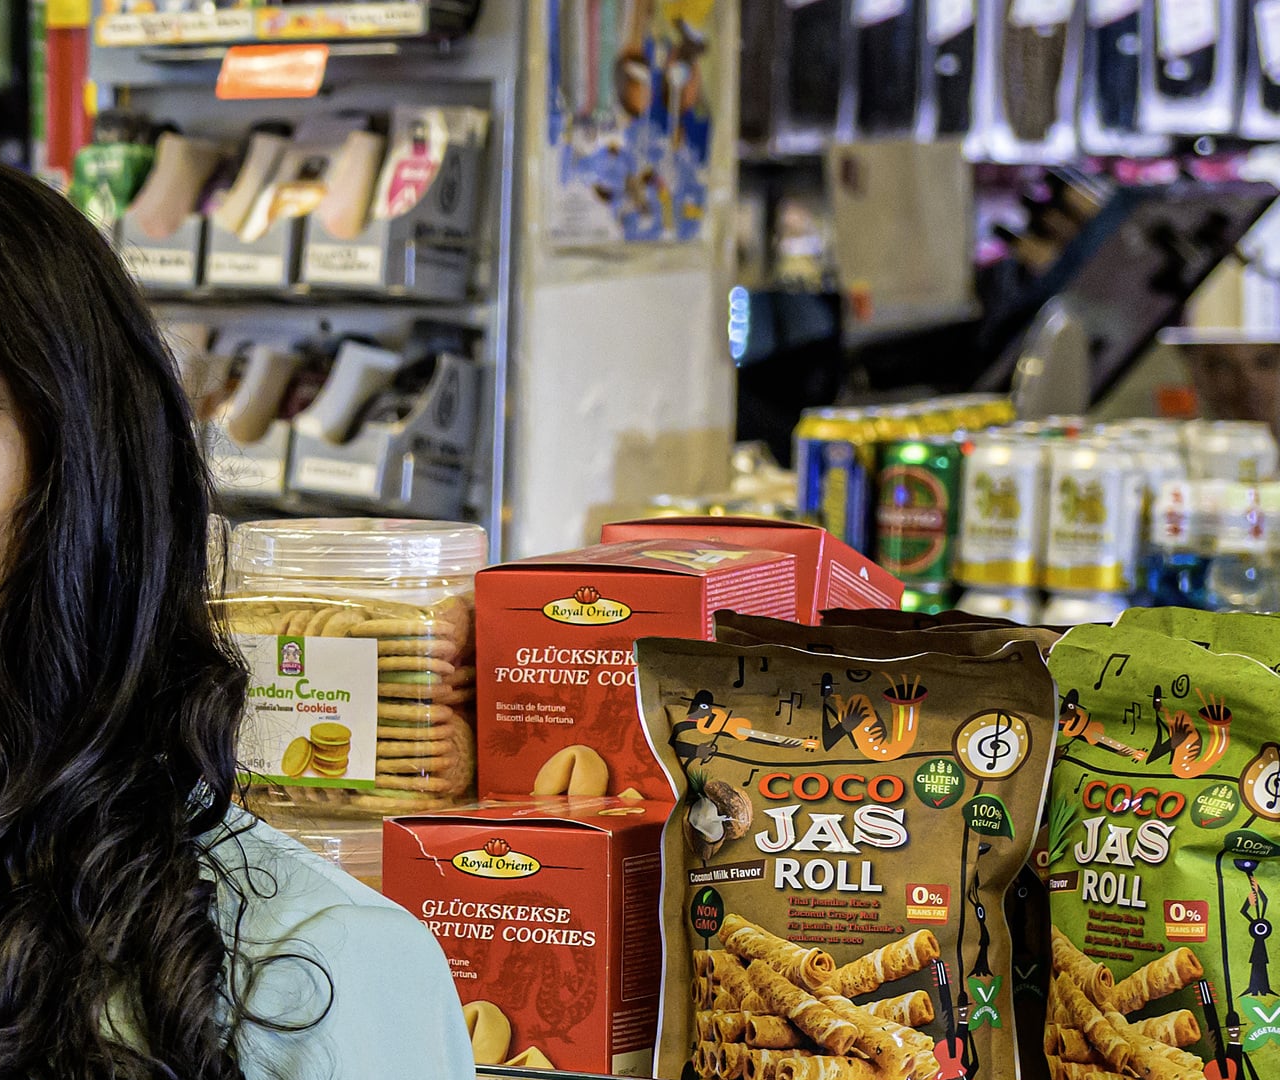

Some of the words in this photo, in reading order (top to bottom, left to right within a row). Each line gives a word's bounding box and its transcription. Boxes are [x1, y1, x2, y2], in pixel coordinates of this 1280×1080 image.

[552, 605, 583, 619] Royal
[586, 606, 623, 617] Orient
[516, 646, 638, 666] GLÜCKSKEK
[495, 668, 590, 685] FORTUNE
[295, 679, 351, 702] Cream
[297, 702, 337, 714] Cookies
[496, 702, 524, 710] Biscuits
[526, 702, 535, 711] de
[537, 703, 566, 712] fortune
[496, 713, 523, 722] Biscotti
[525, 714, 543, 723] della
[545, 715, 574, 724] fortuna
[759, 772, 905, 802] COCO
[916, 774, 959, 786] GLUTEN
[925, 784, 950, 794] FREE
[1083, 780, 1186, 819] COCO
[1197, 795, 1235, 811] GLUTEN
[972, 804, 1003, 820] 100%
[1199, 805, 1223, 817] FREE
[755, 804, 908, 854] JAS
[1074, 815, 1175, 867] JAS
[461, 856, 493, 871] Royal
[496, 858, 534, 871] Orient
[690, 872, 712, 883] Coconut
[713, 870, 728, 880] Milk
[730, 866, 761, 878] Flavor
[774, 857, 883, 892] ROLL
[912, 886, 943, 904] 0%
[1082, 869, 1146, 909] ROLL
[789, 897, 809, 907] Thai
[848, 898, 870, 908] Rice
[422, 899, 570, 924] GLÜCKSKEKSE
[696, 905, 717, 917] NON
[788, 909, 825, 918] Coconut
[827, 910, 857, 921] Crispy
[860, 911, 878, 920] Roll
[933, 909, 946, 917] FAT
[1169, 903, 1201, 921] 0%
[695, 919, 717, 931] GMO
[1191, 926, 1205, 934] FAT
[502, 926, 596, 947] COOKIES
[841, 937, 863, 945] coco
